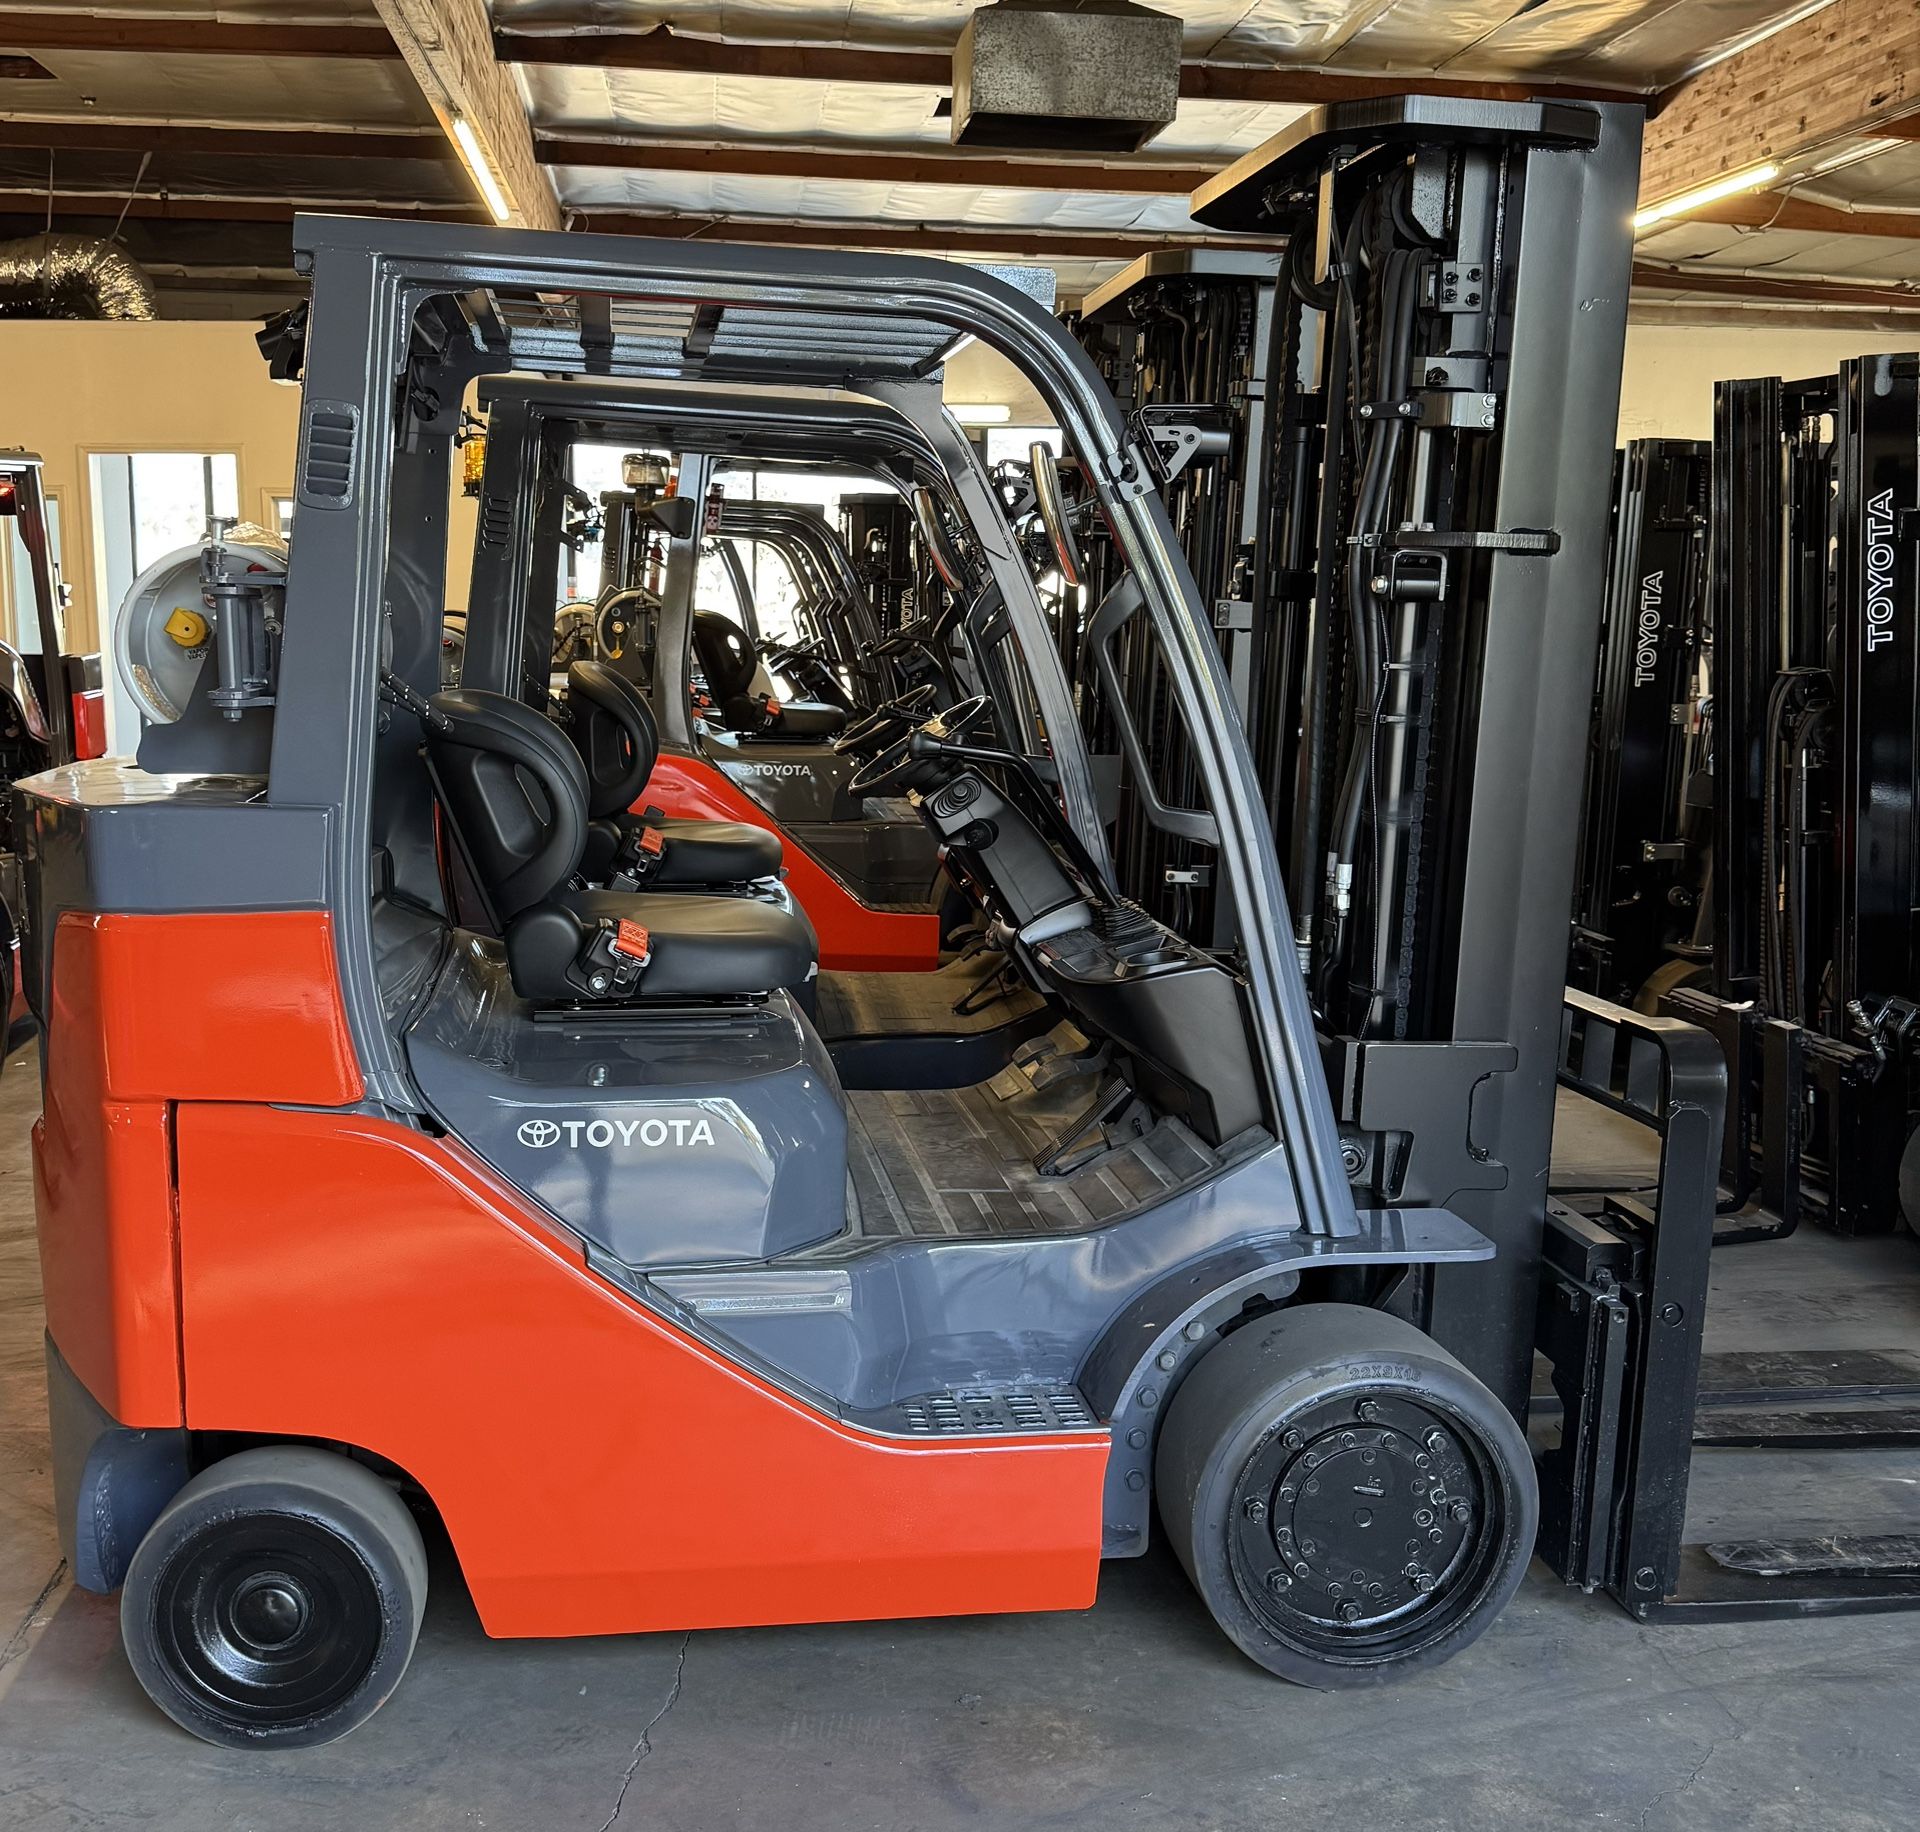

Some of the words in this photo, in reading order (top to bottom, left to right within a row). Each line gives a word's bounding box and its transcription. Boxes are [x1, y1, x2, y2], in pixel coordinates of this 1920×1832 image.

[1867, 488, 1894, 652] TOYOTA
[901, 587, 914, 631] YOTA
[1634, 570, 1664, 687] TOYOTA
[754, 765, 811, 776] TOYOTA
[562, 1119, 716, 1149] TOYOTA
